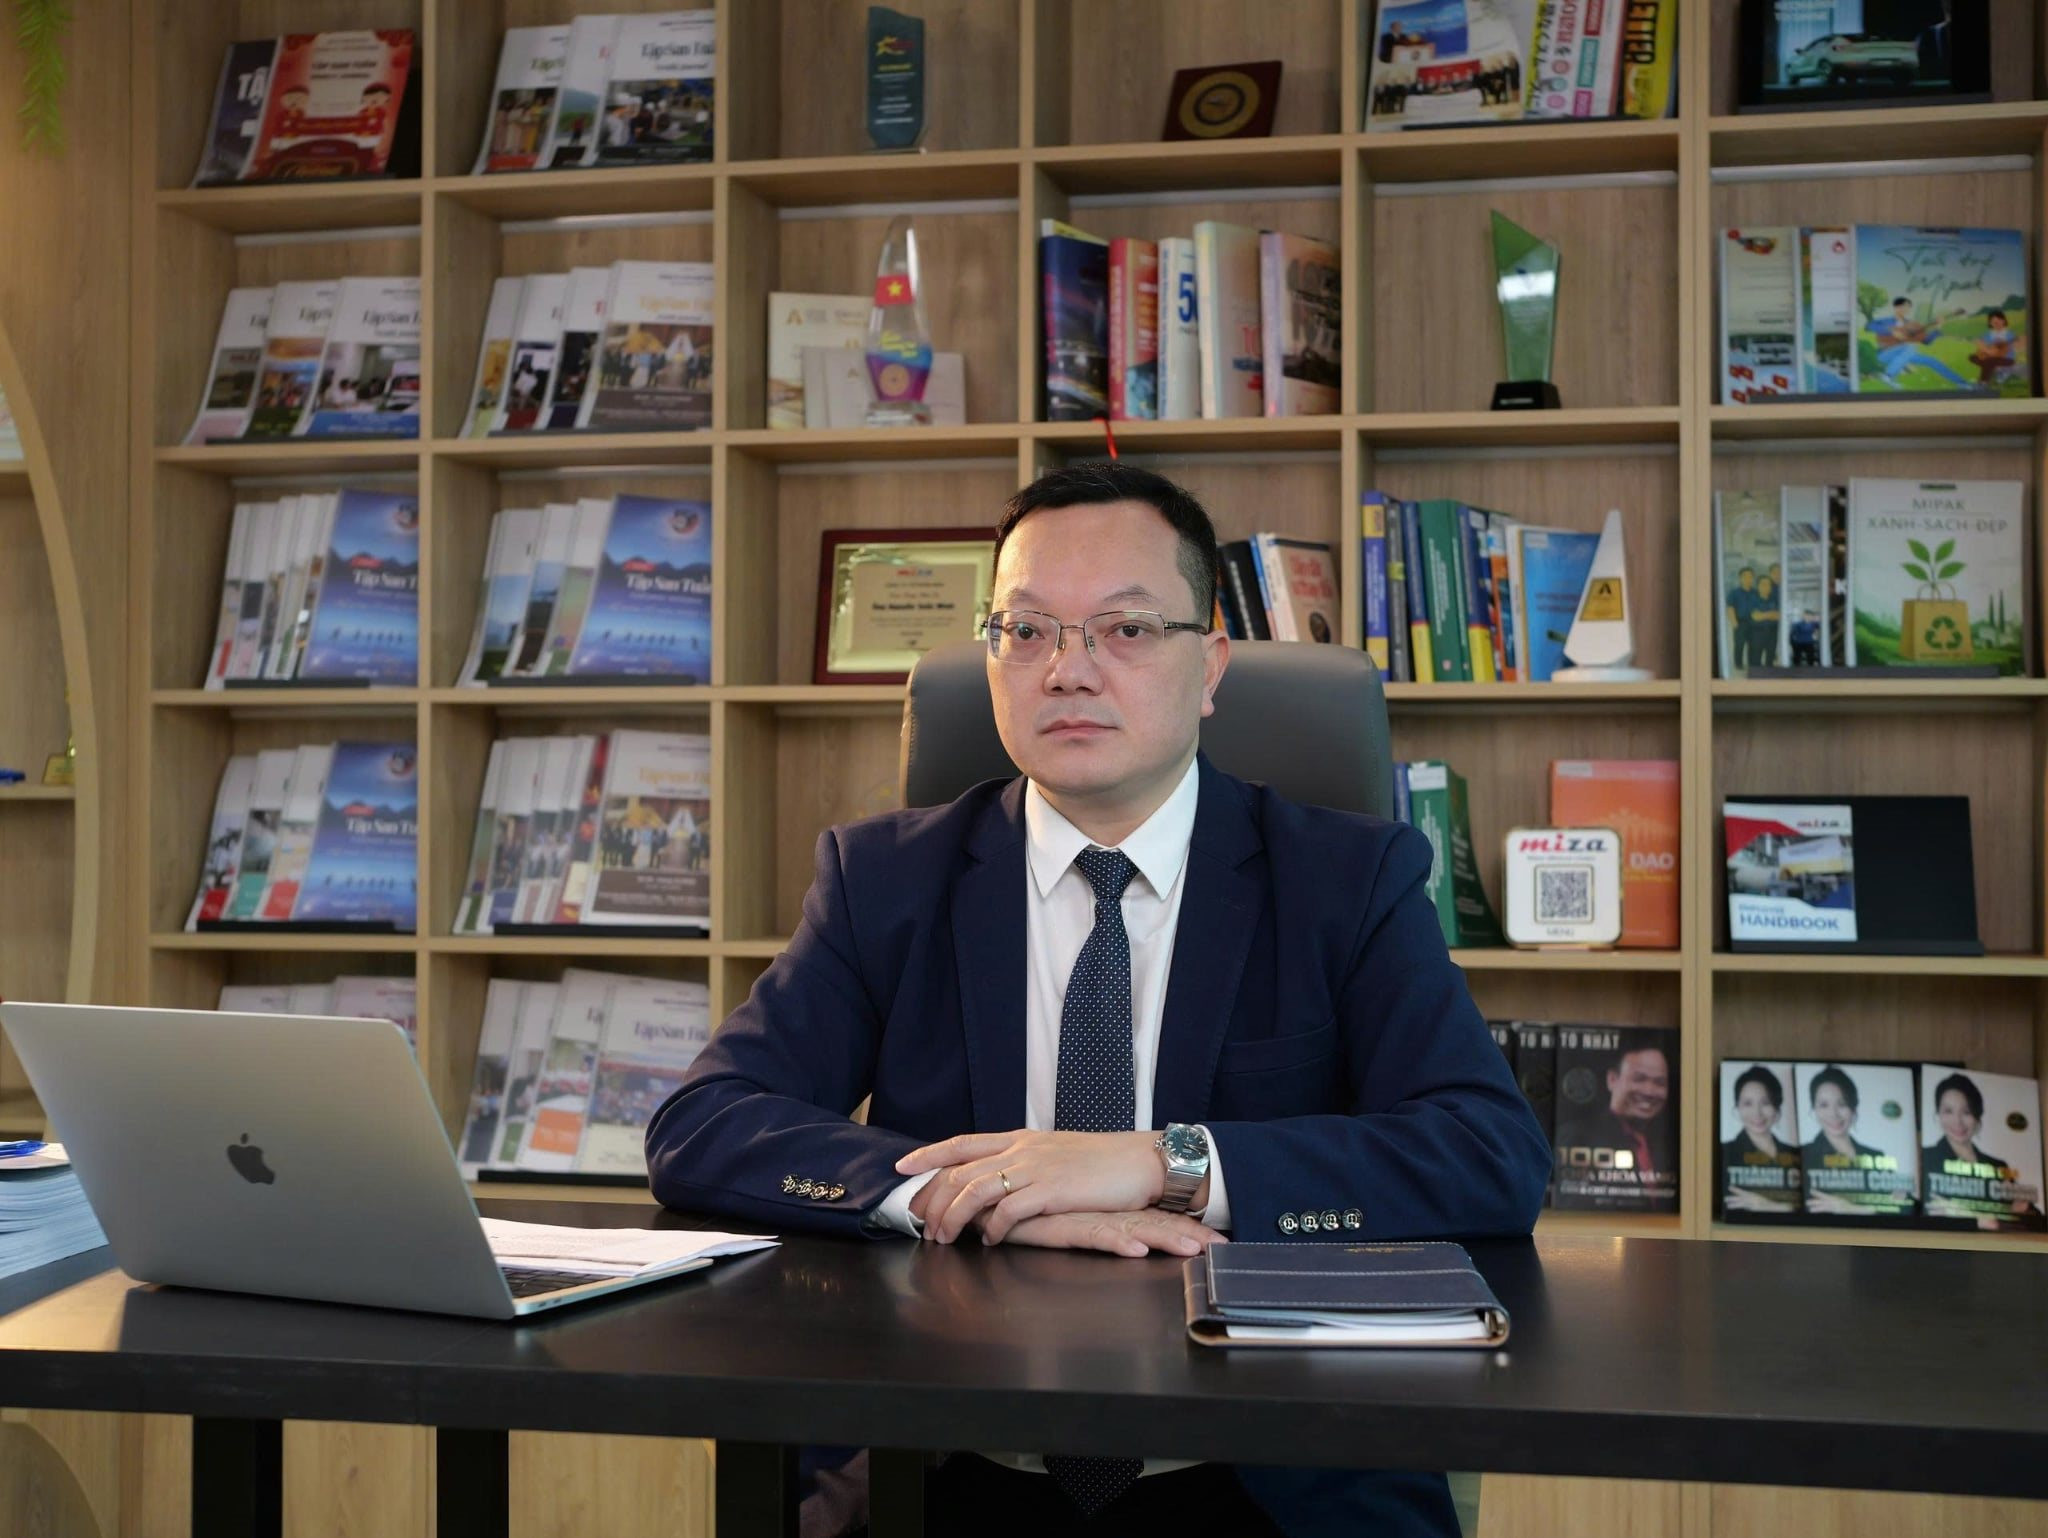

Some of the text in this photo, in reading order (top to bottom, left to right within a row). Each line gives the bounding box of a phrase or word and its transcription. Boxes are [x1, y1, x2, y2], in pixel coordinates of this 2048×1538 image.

[1178, 273, 1198, 323] 5
[1912, 499, 1966, 511] MIPAK
[1519, 832, 1609, 853] miza
[1740, 913, 1840, 930] HANDBOOK
